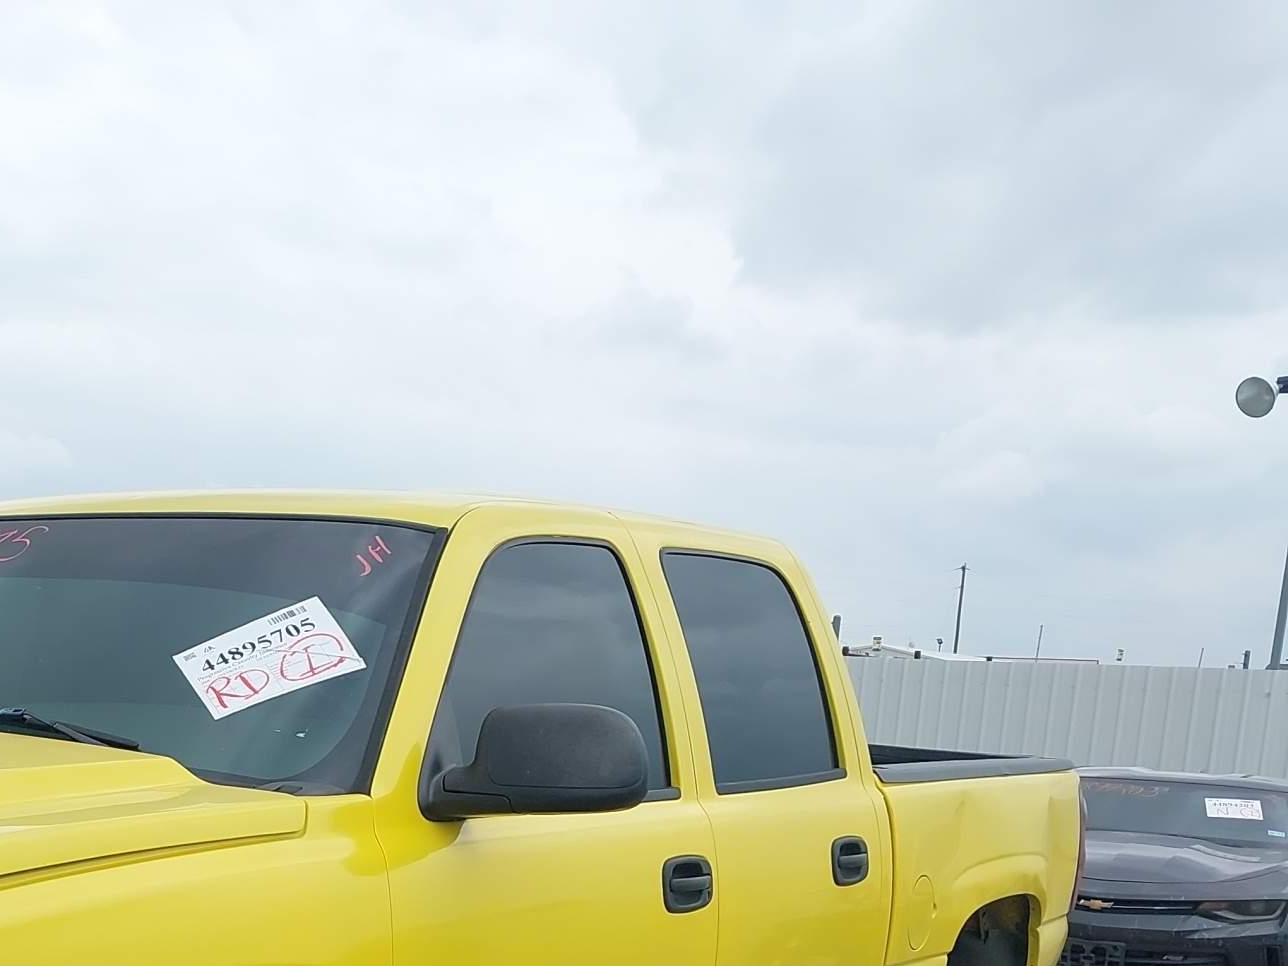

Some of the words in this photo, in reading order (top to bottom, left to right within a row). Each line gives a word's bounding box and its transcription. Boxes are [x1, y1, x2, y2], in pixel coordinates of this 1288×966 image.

[355, 535, 392, 577] JH
[201, 617, 316, 673] 44895705
[206, 669, 270, 709] RD
